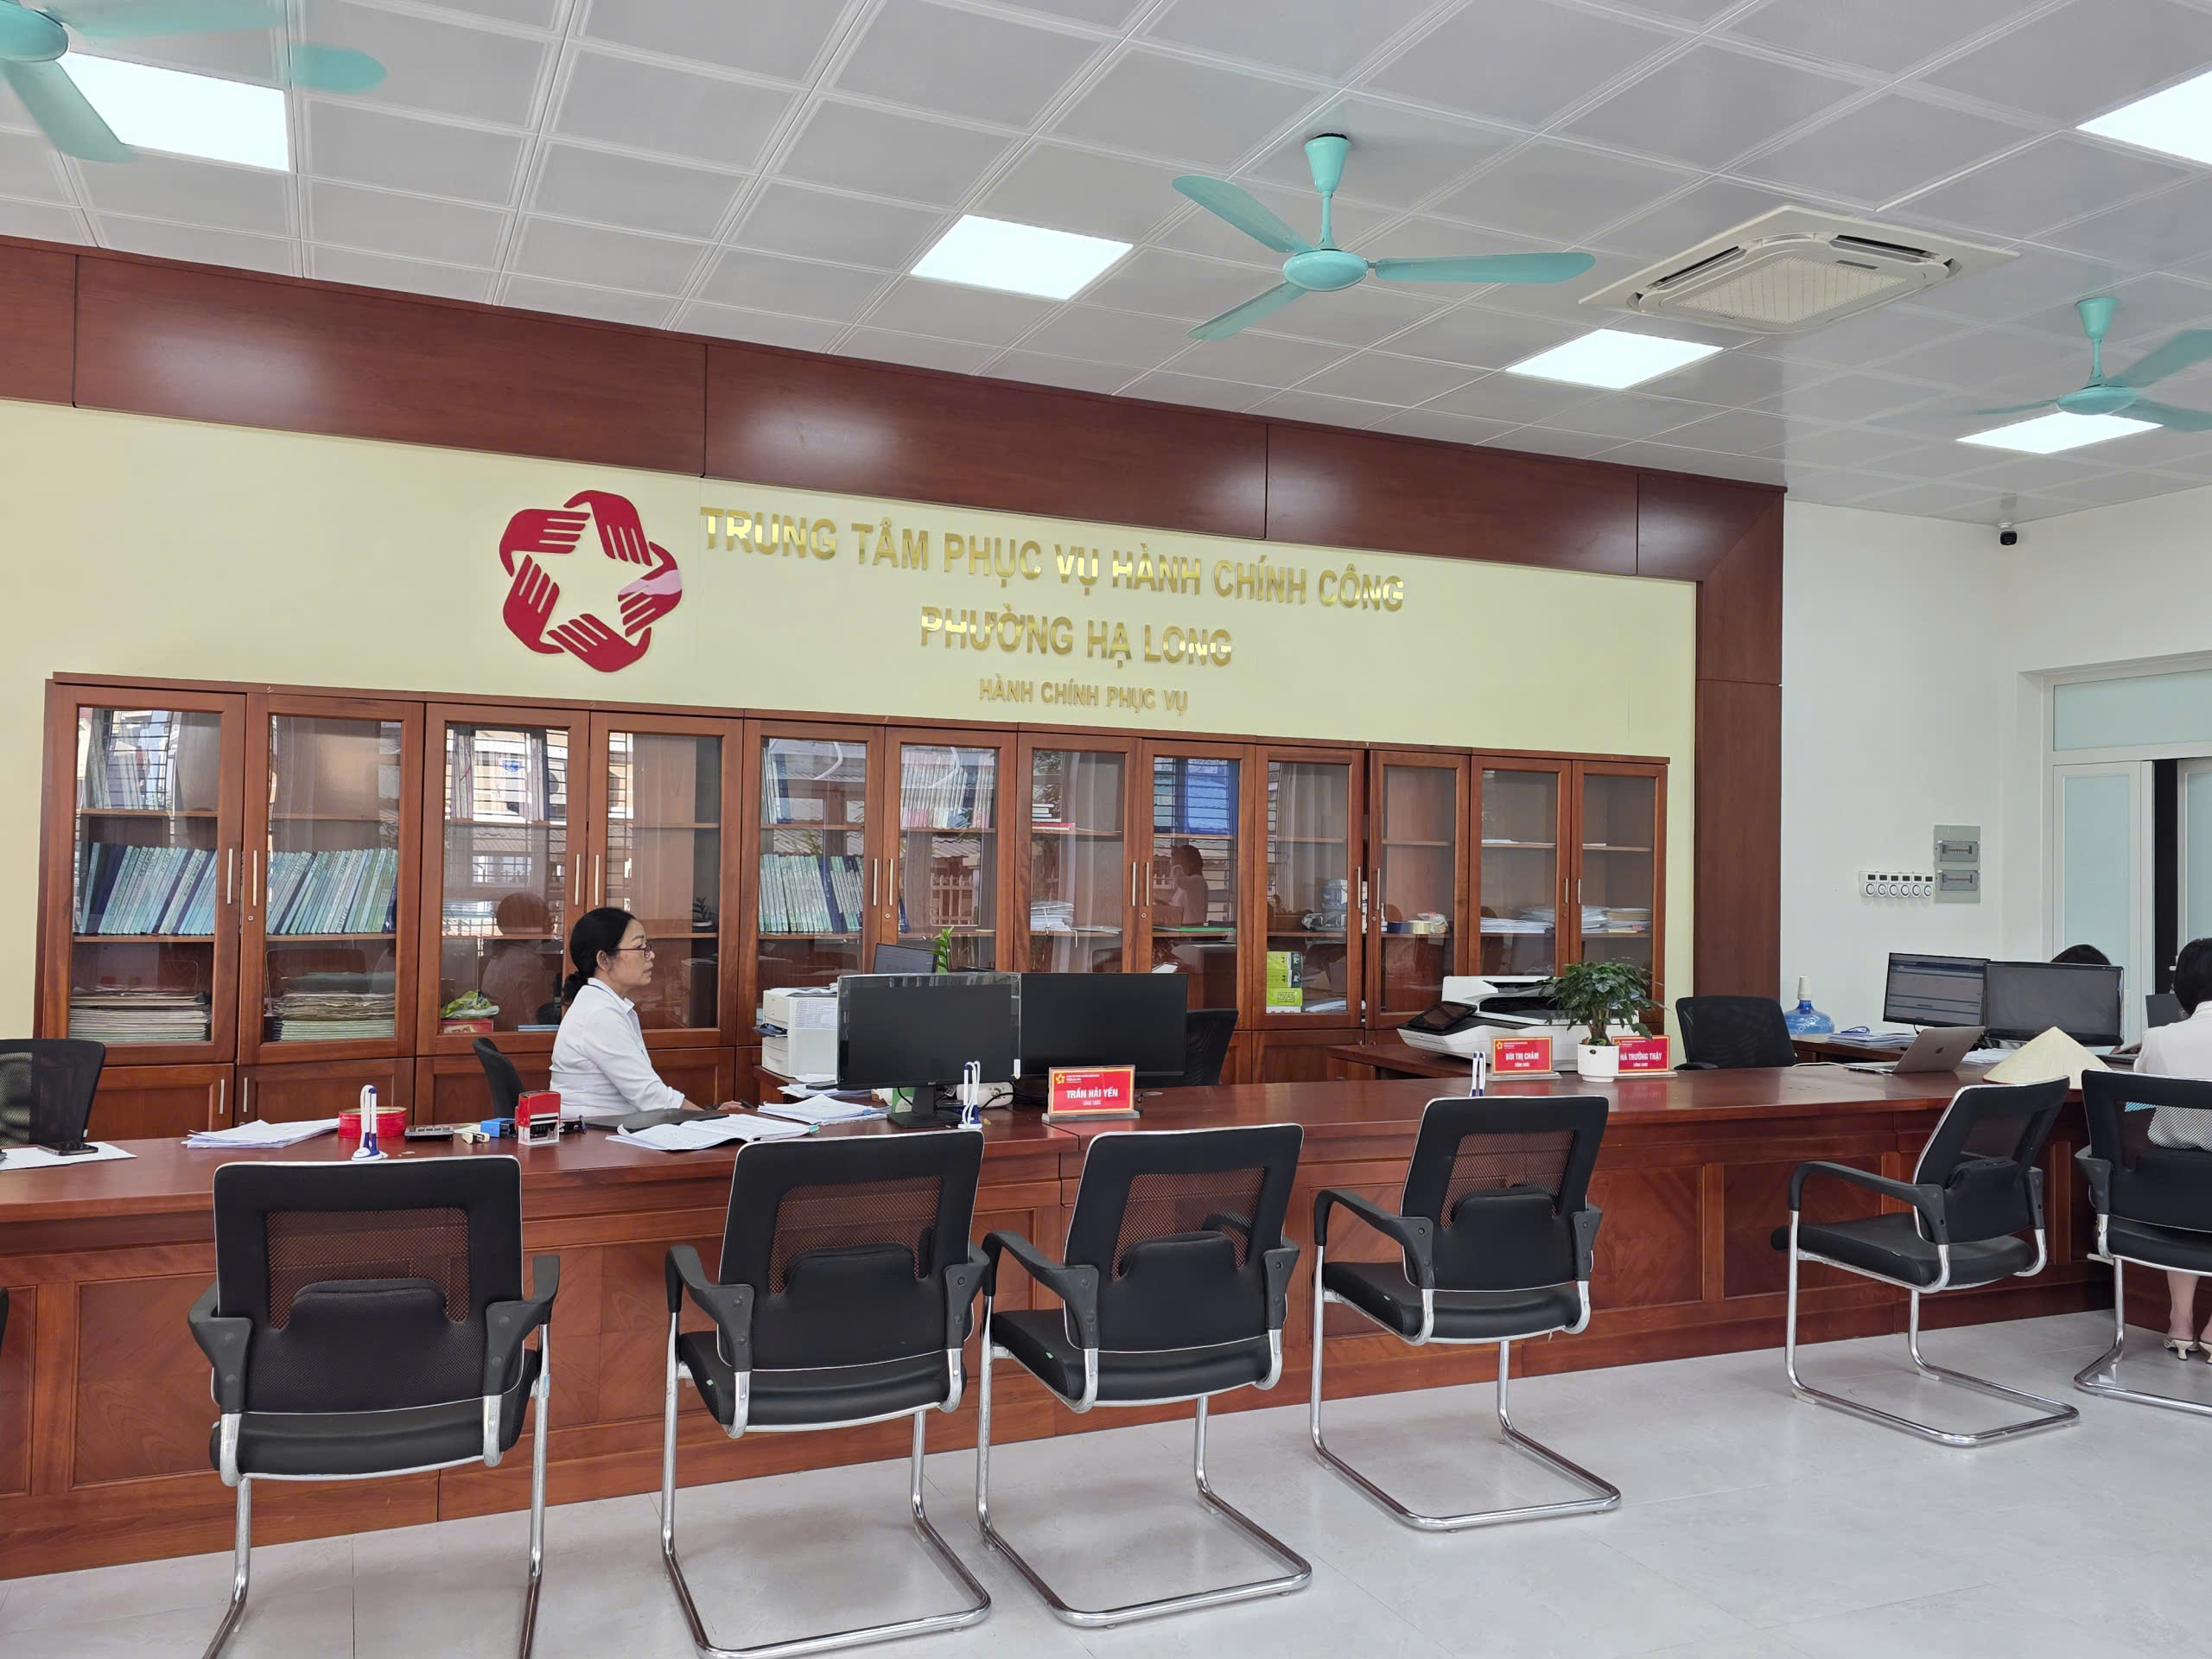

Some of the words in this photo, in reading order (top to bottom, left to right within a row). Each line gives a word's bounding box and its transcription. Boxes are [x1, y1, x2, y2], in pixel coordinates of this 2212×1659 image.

[700, 506, 837, 561] TRUNG
[850, 517, 929, 571] TÂM
[944, 532, 1043, 588] PHỤC
[1053, 543, 1099, 596] VỤ
[1111, 542, 1201, 595] HÀNH
[1212, 555, 1307, 605] CHÍNH
[1318, 563, 1404, 613] CÔNG
[921, 602, 1073, 656] PHƯỜNG
[1087, 620, 1132, 670] HẠ
[1143, 624, 1232, 667] LONG
[979, 672, 1033, 702] HÀNH
[1040, 677, 1099, 707] CHÍNH
[1106, 685, 1155, 714] PHỤC
[1162, 689, 1189, 716] VỤ
